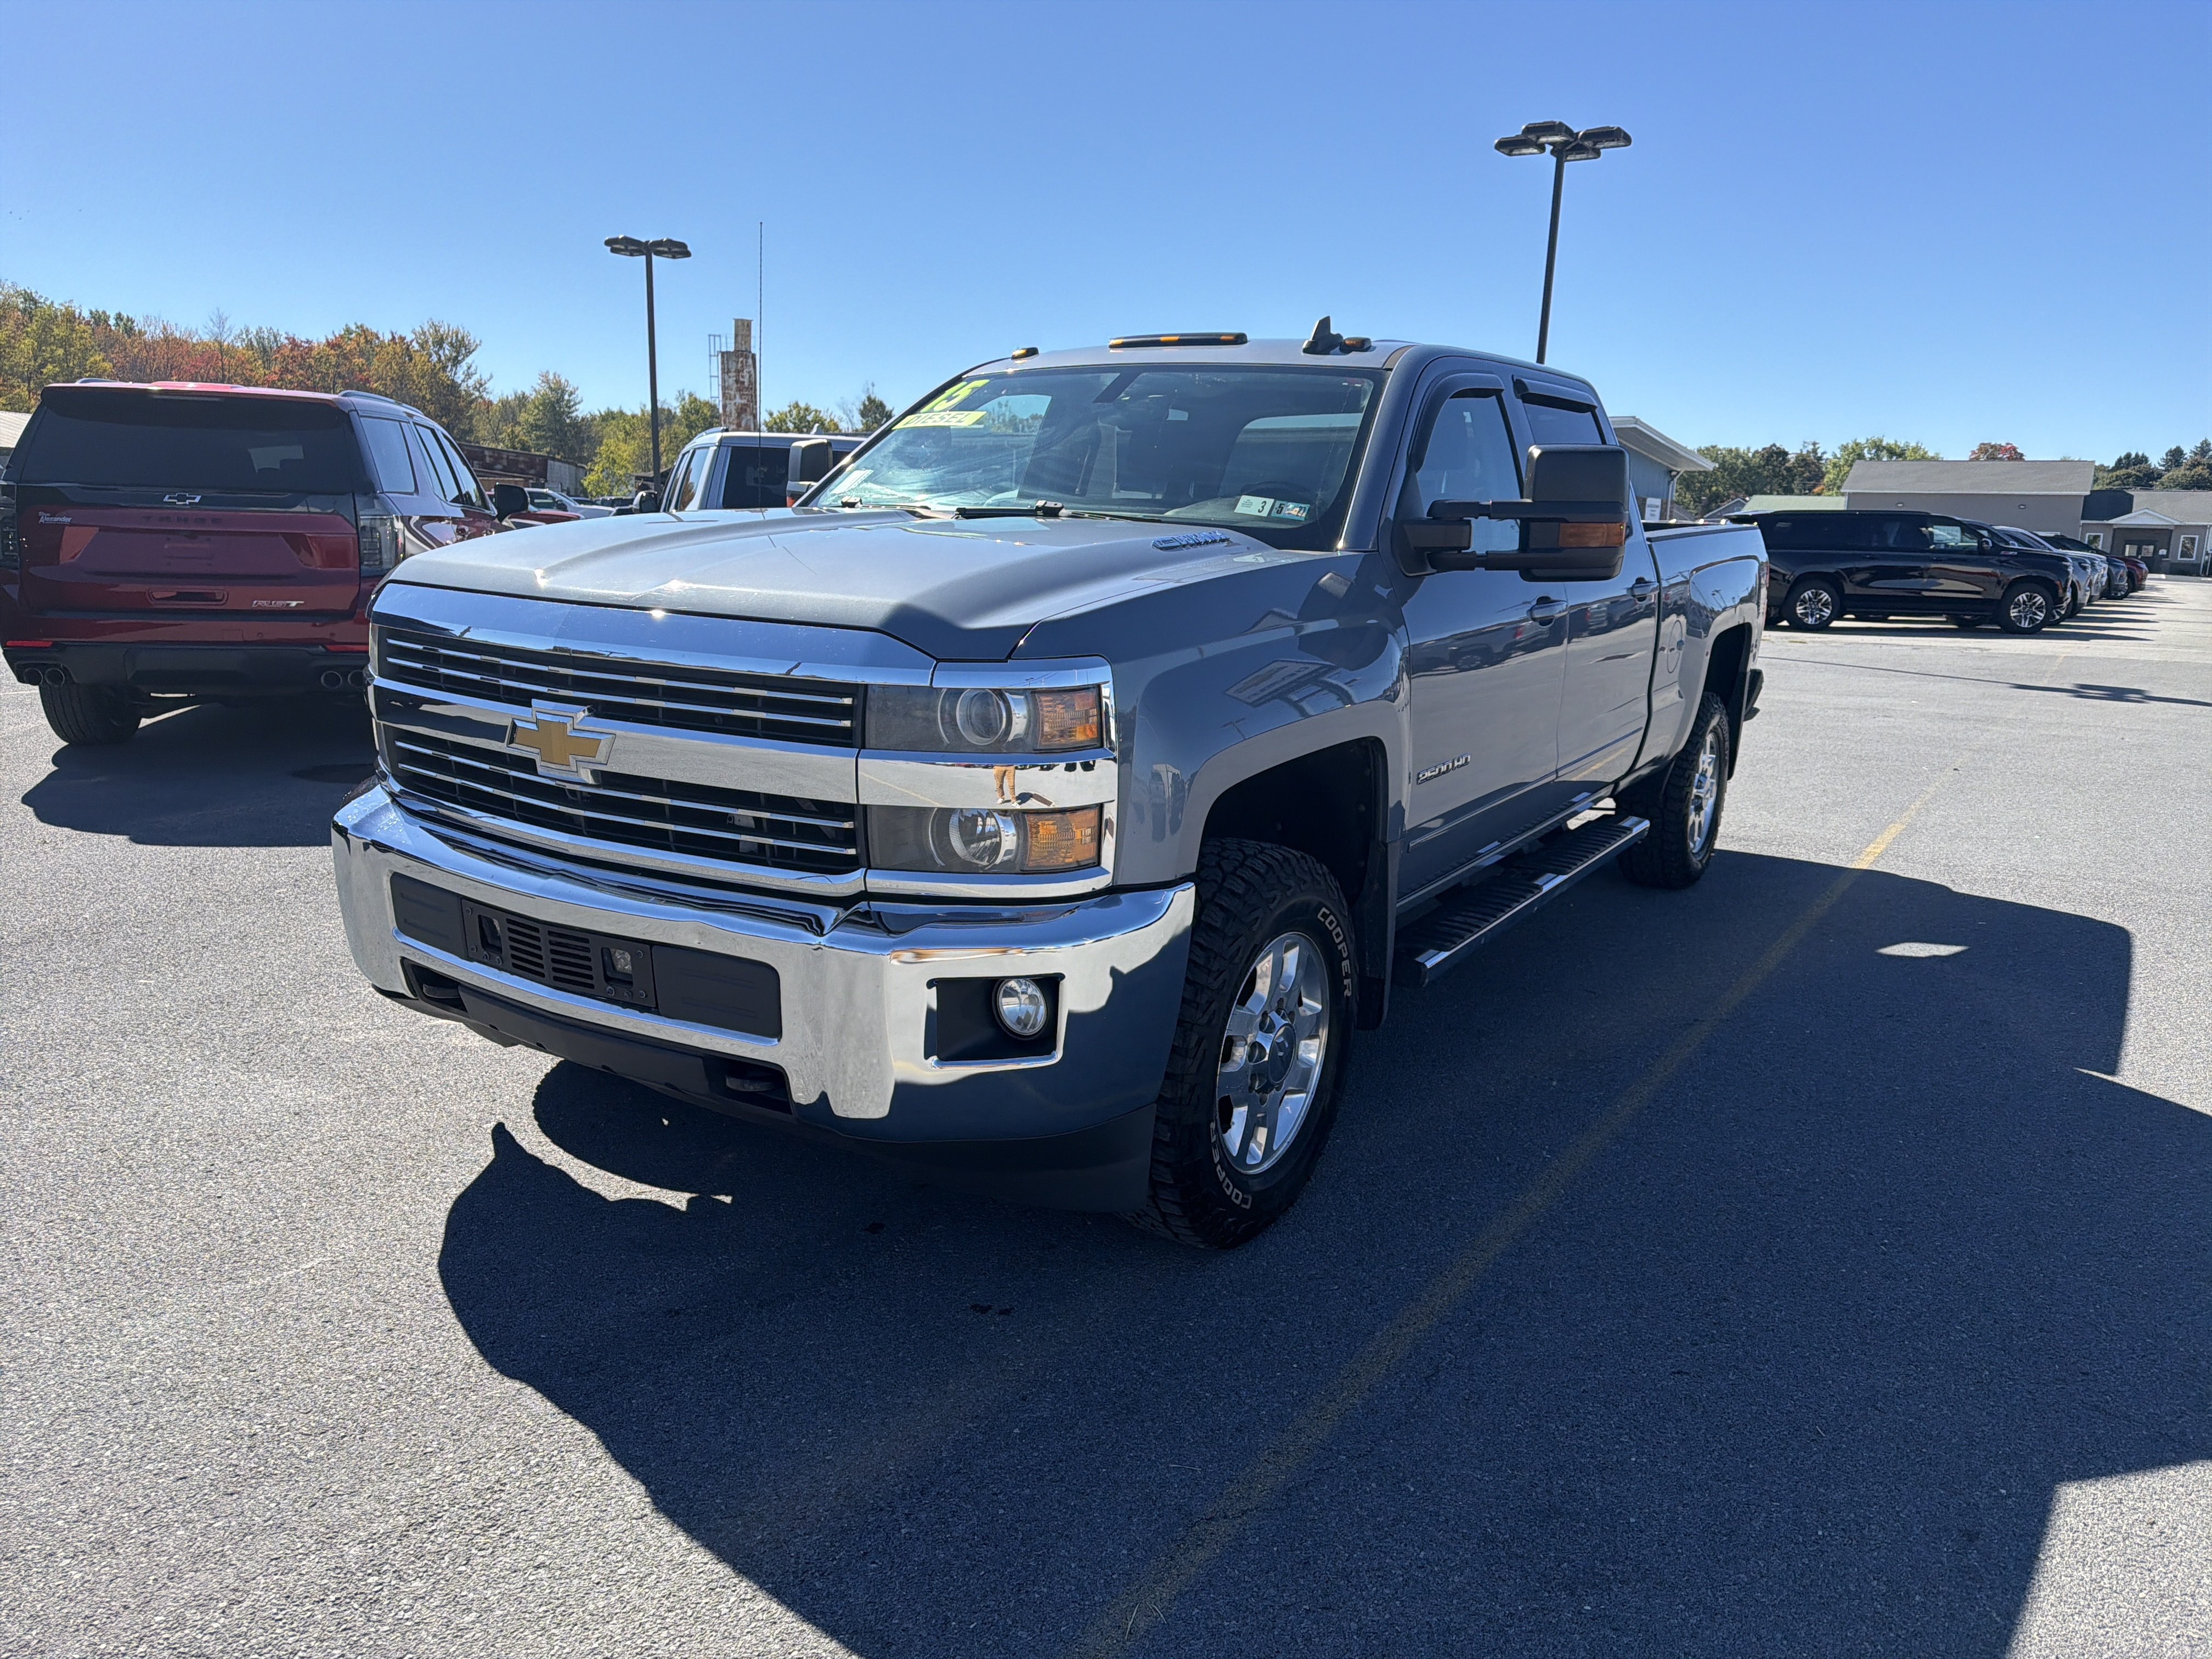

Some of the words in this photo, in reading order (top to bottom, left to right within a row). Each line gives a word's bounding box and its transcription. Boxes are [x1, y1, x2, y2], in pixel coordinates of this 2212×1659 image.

[902, 413, 971, 426] DIESEL
[1258, 501, 1267, 513] 3
[1317, 907, 1352, 997] COOPER
[1210, 1121, 1252, 1209] COOPER
